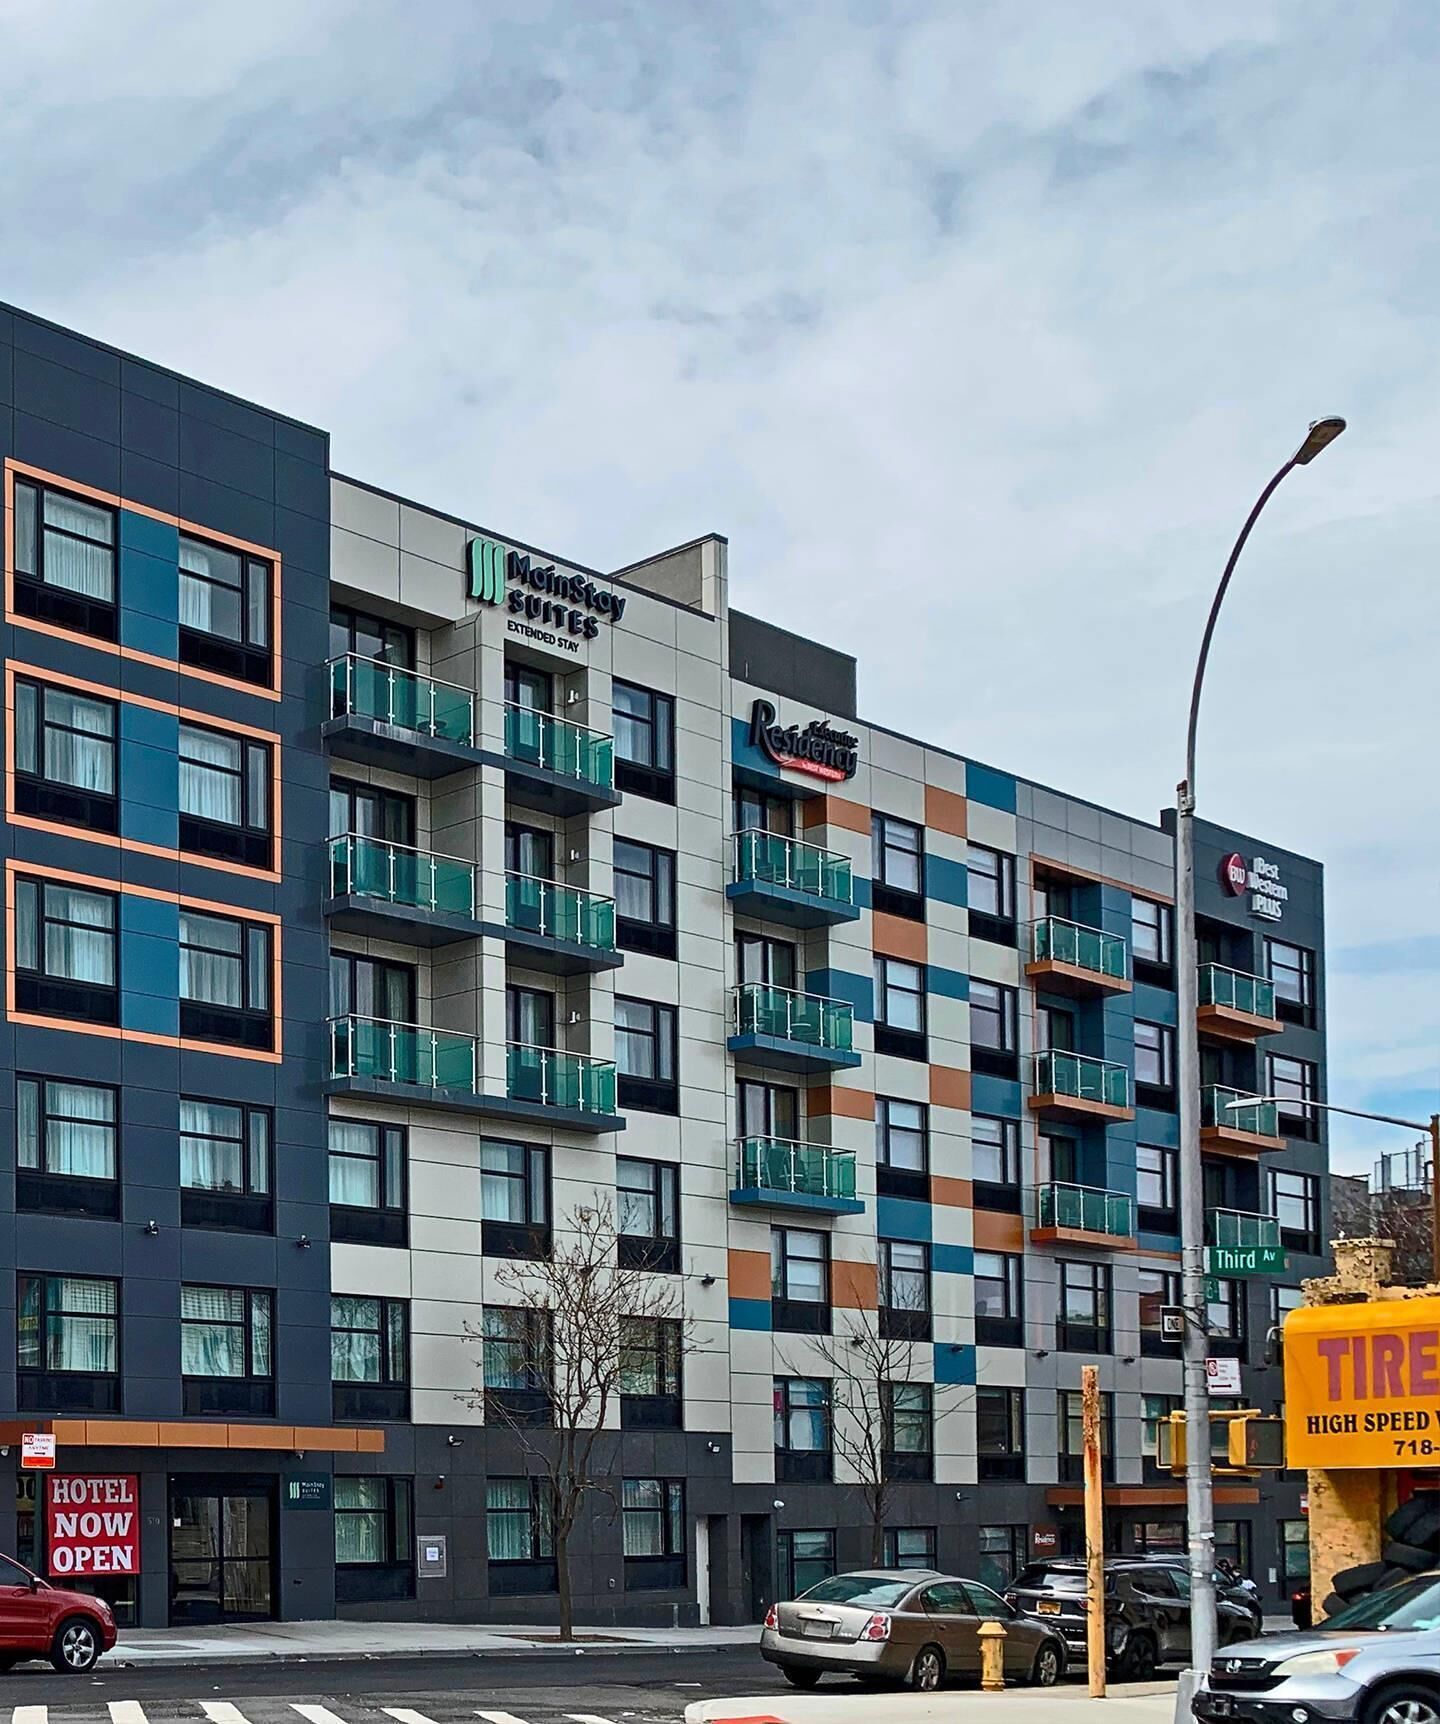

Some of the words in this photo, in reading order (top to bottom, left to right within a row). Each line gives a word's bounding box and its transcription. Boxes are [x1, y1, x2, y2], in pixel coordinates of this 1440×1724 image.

[507, 550, 627, 623] MainStay
[507, 588, 600, 640] SUITES
[507, 619, 556, 646] EXTENDED
[557, 637, 580, 653] STAY
[748, 698, 858, 780] Residency
[1252, 856, 1280, 880] Best
[1245, 871, 1289, 901] Western
[1216, 1249, 1256, 1269] Third
[1263, 1249, 1276, 1261] Av
[1306, 1413, 1358, 1435] HIGH
[1363, 1410, 1430, 1433] SPEED
[24, 1435, 34, 1444] NO
[1393, 1439, 1440, 1456] 718-
[52, 1478, 133, 1504] HOTEL
[53, 1511, 134, 1539] NOW
[52, 1545, 134, 1573] OPEN
